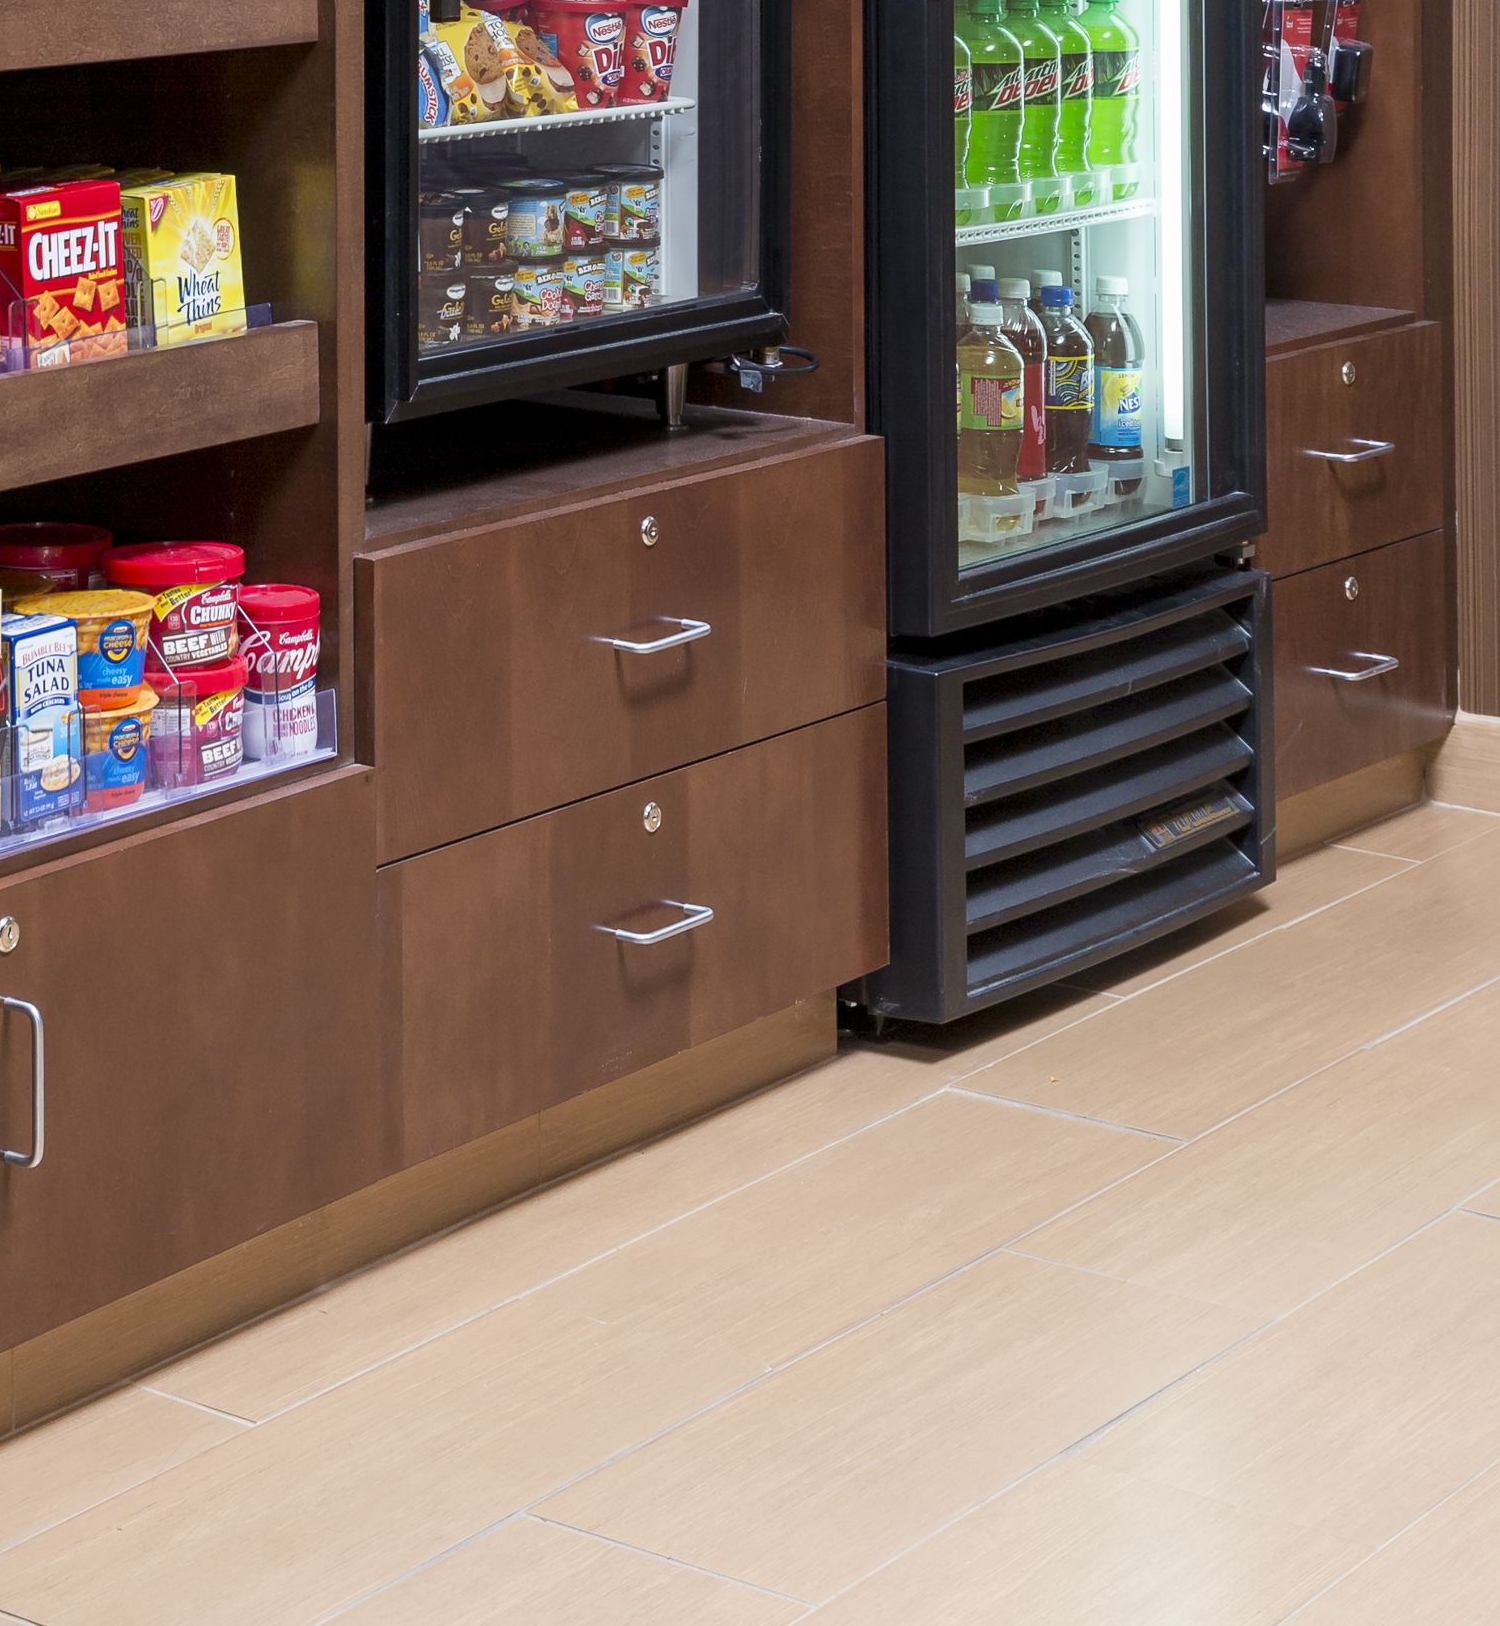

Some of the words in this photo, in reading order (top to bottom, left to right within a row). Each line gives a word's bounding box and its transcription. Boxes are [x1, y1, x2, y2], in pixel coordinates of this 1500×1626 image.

[121, 219, 140, 230] hins
[28, 220, 119, 282] CHEEZ-IT
[177, 271, 222, 305] Wheat
[177, 296, 222, 326] Thins
[1119, 398, 1142, 412] NES
[190, 602, 237, 625] CHUNKY
[22, 642, 52, 666] BUMBLE
[163, 634, 209, 655] BEEF
[165, 652, 191, 664] COUNTRY
[27, 658, 66, 682] TUNA
[111, 673, 133, 688] easy
[24, 676, 71, 704] SALAD
[201, 741, 237, 764] BEEF
[121, 771, 140, 785] easy
